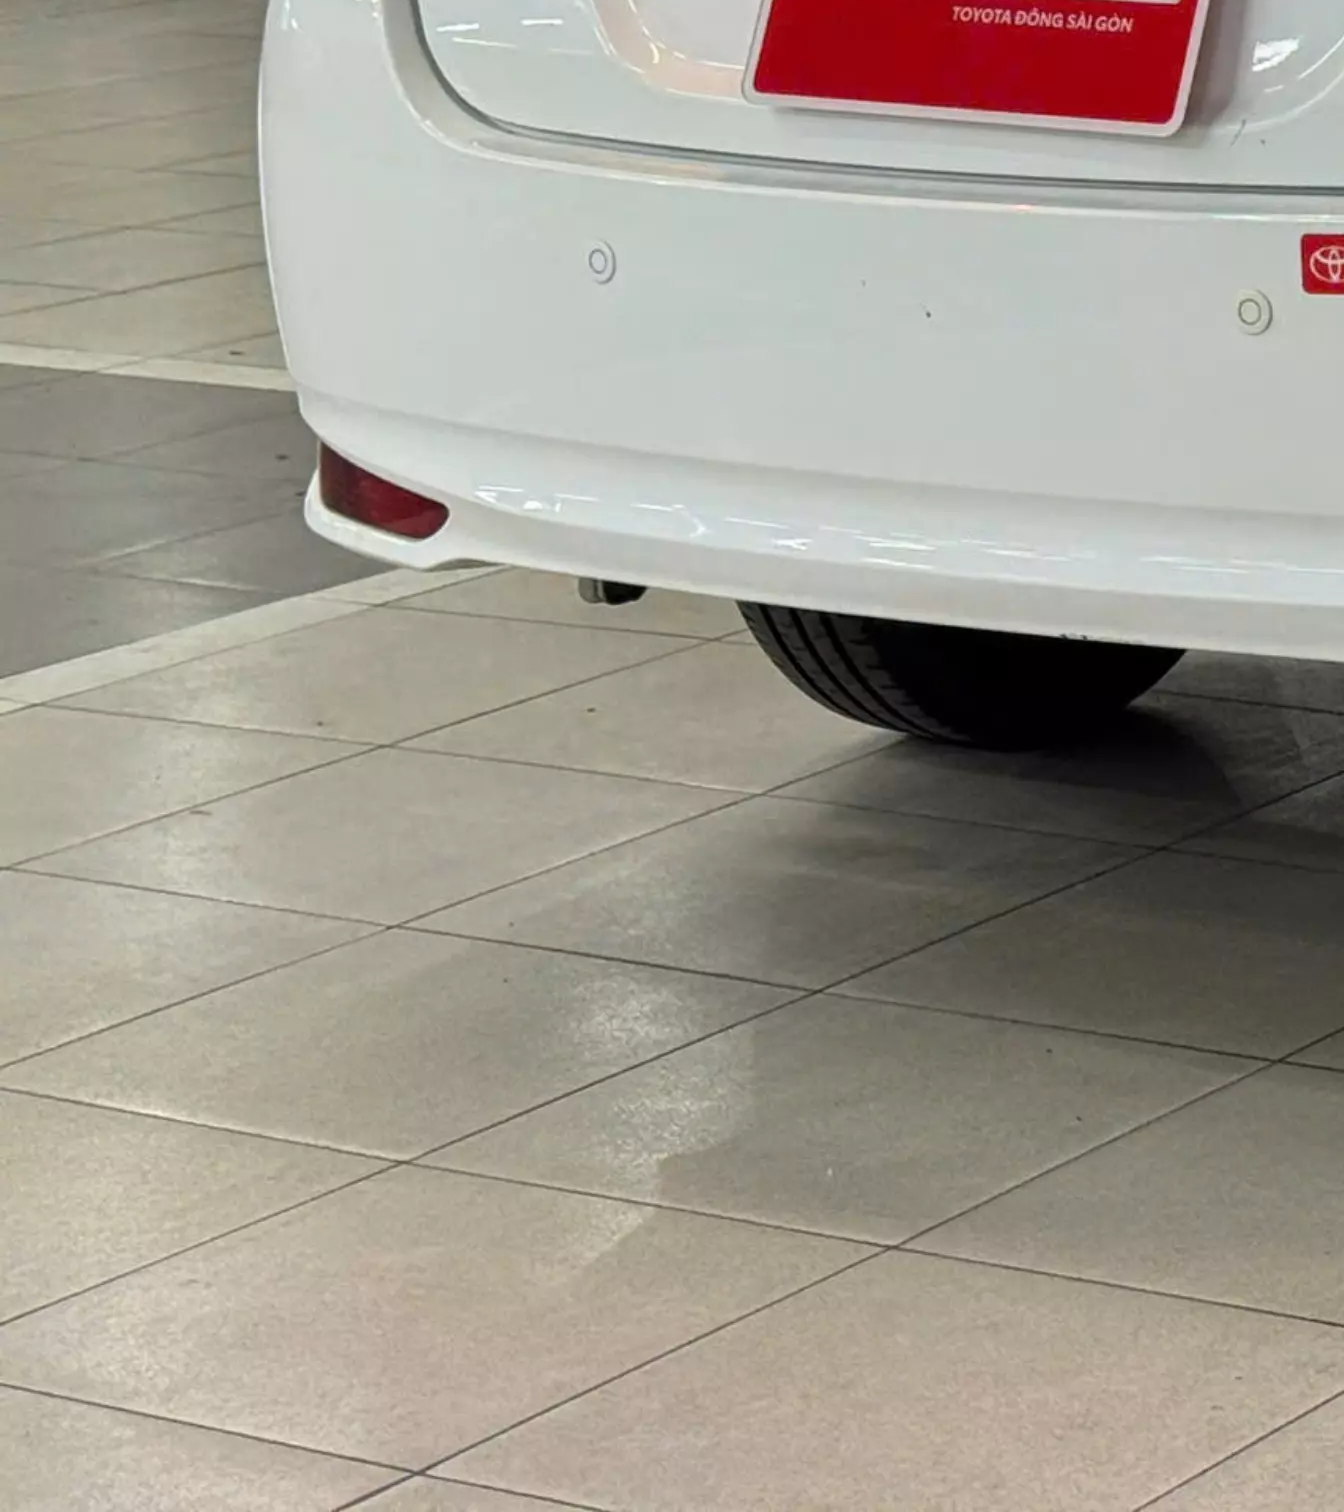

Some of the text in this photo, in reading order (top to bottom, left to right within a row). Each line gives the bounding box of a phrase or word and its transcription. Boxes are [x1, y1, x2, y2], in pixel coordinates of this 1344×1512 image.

[952, 6, 1134, 33] TOYOTA ĐÔNG SÀI GÒN
